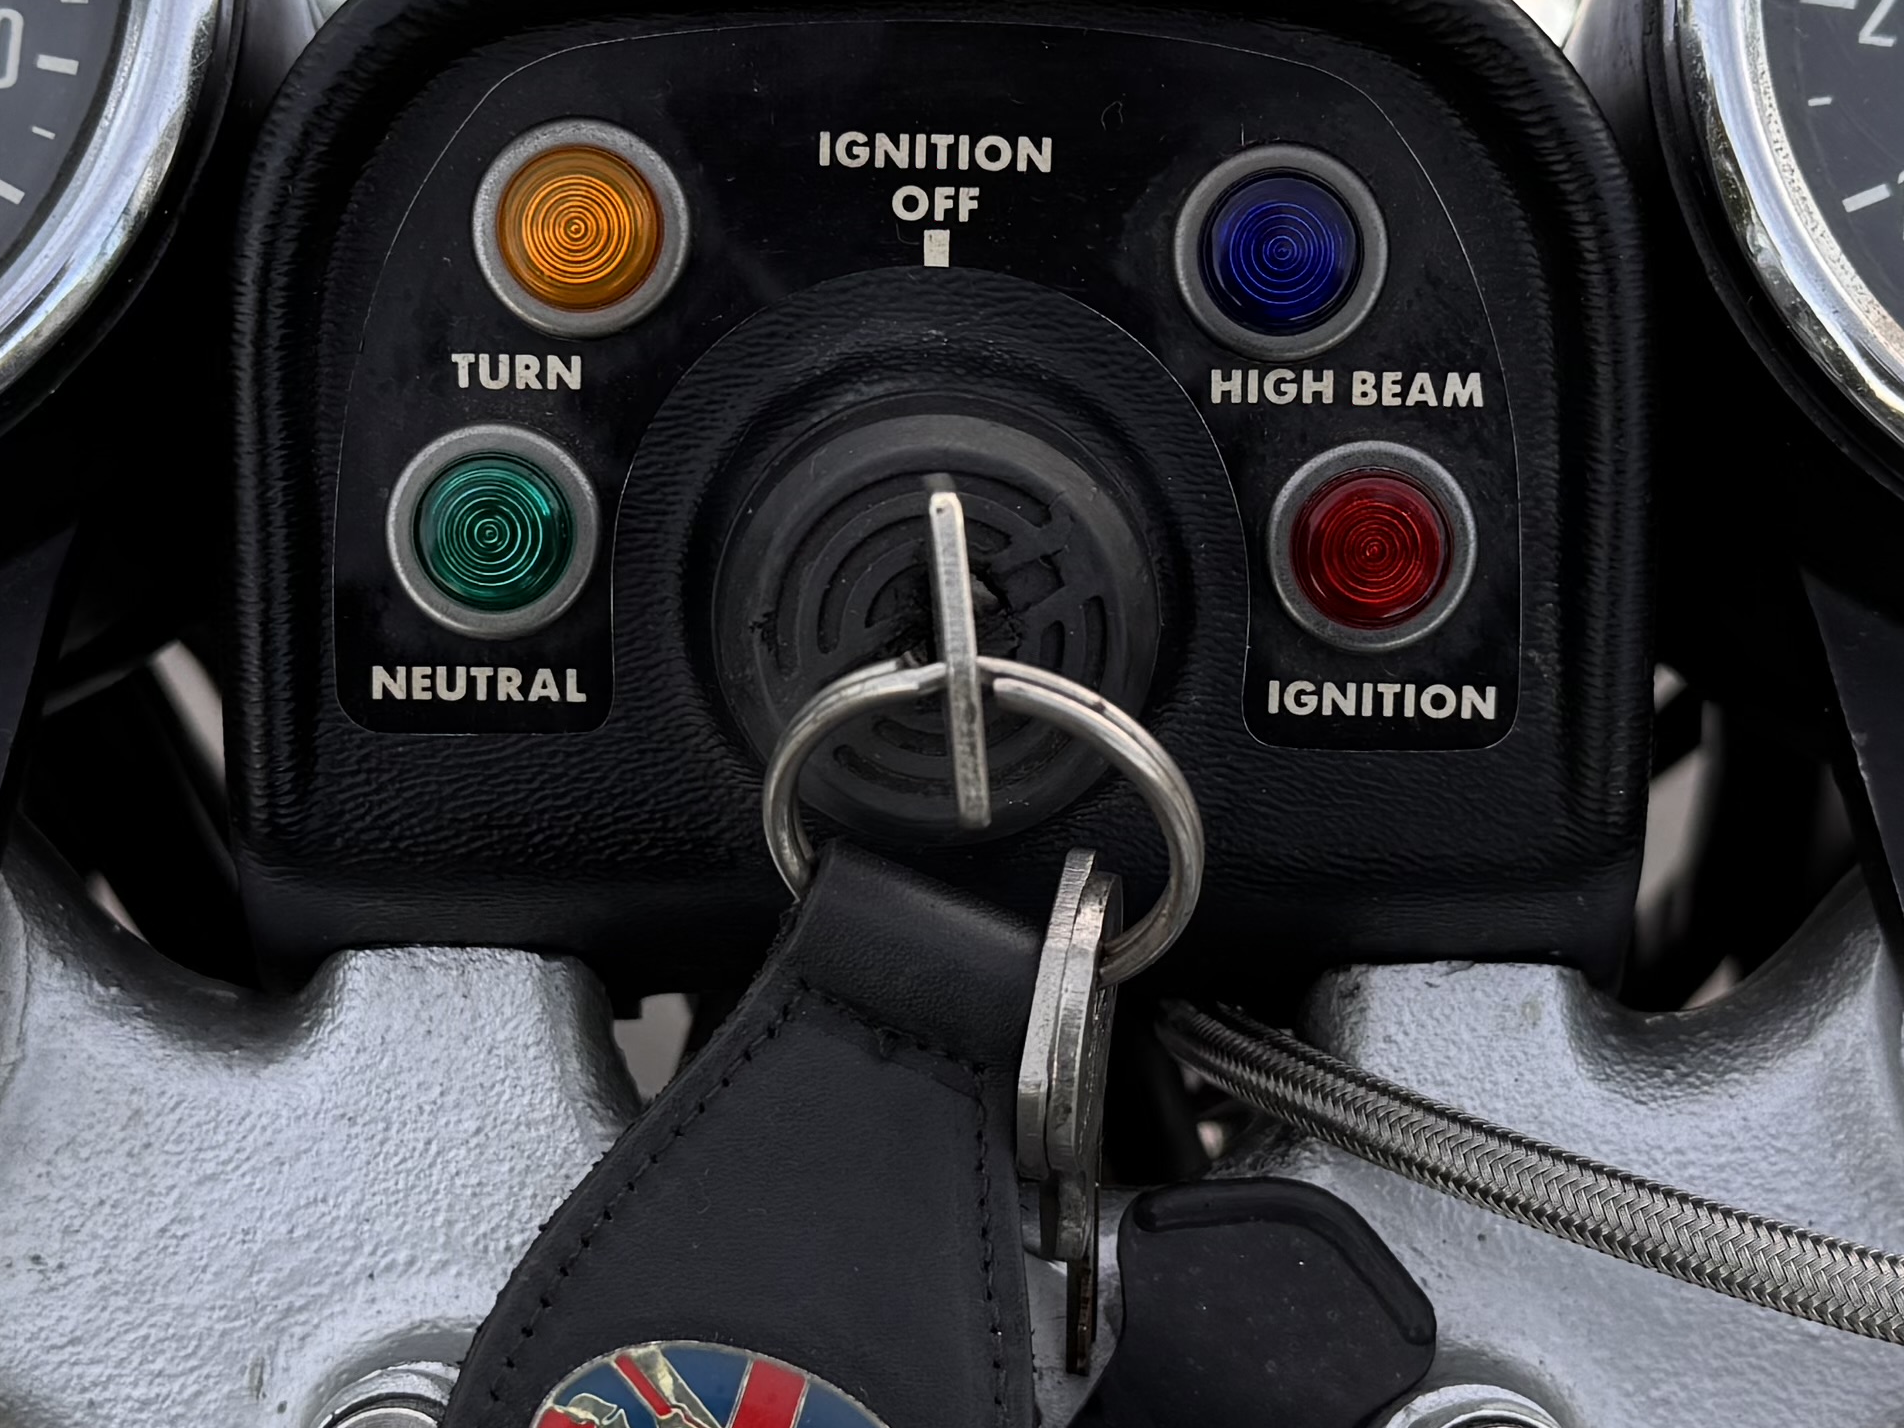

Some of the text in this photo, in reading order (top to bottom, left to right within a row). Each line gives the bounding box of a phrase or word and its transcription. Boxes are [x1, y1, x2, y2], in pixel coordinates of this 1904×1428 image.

[819, 131, 1052, 173] IGNITION
[892, 185, 980, 222] OFF
[451, 353, 582, 390] TURN
[1211, 368, 1484, 408] HIGH BEAM
[371, 665, 587, 703] NEUTRAL
[1268, 680, 1496, 720] IGNITION
